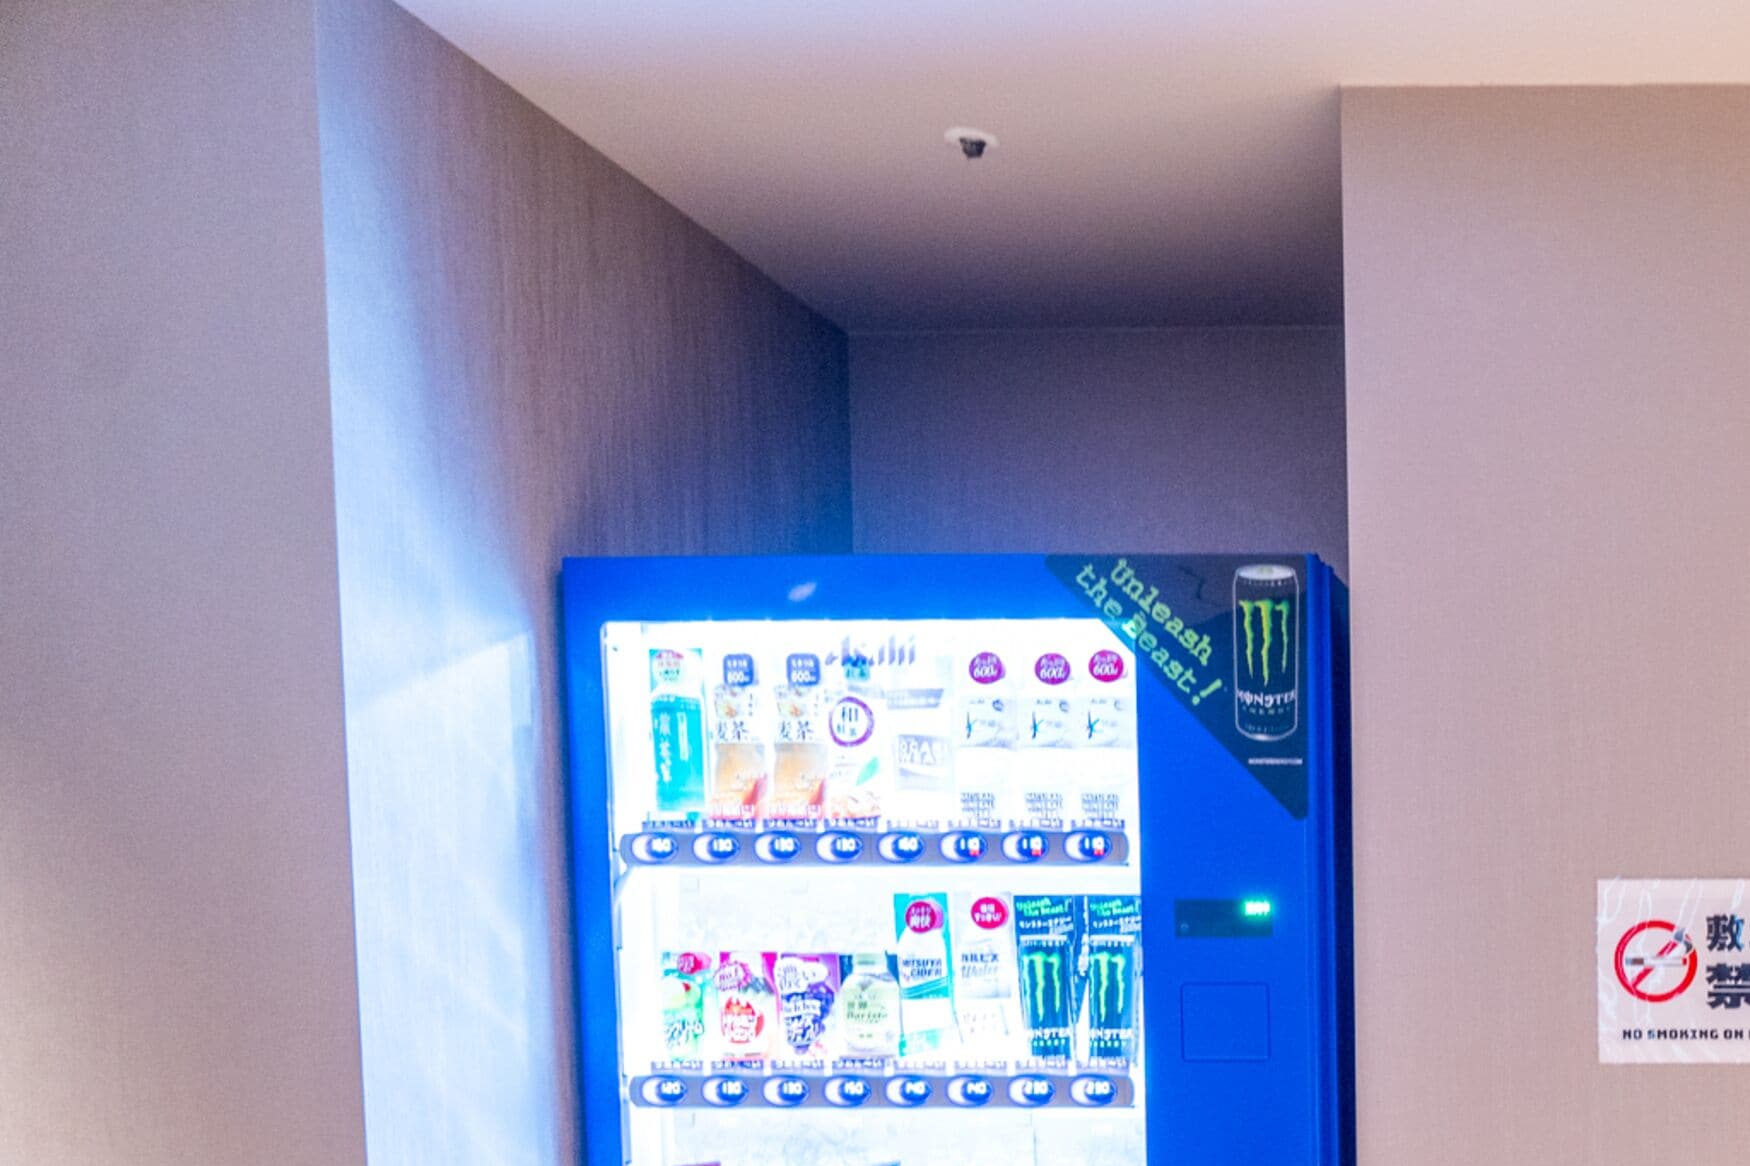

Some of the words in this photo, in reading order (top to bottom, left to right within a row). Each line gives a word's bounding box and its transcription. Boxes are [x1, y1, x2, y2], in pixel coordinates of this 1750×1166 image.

[1076, 564, 1123, 619] the
[1111, 558, 1212, 667] Unleash
[1622, 1028, 1644, 1041] NO
[1647, 1028, 1720, 1041] SMOKING
[1723, 1028, 1745, 1041] ON
